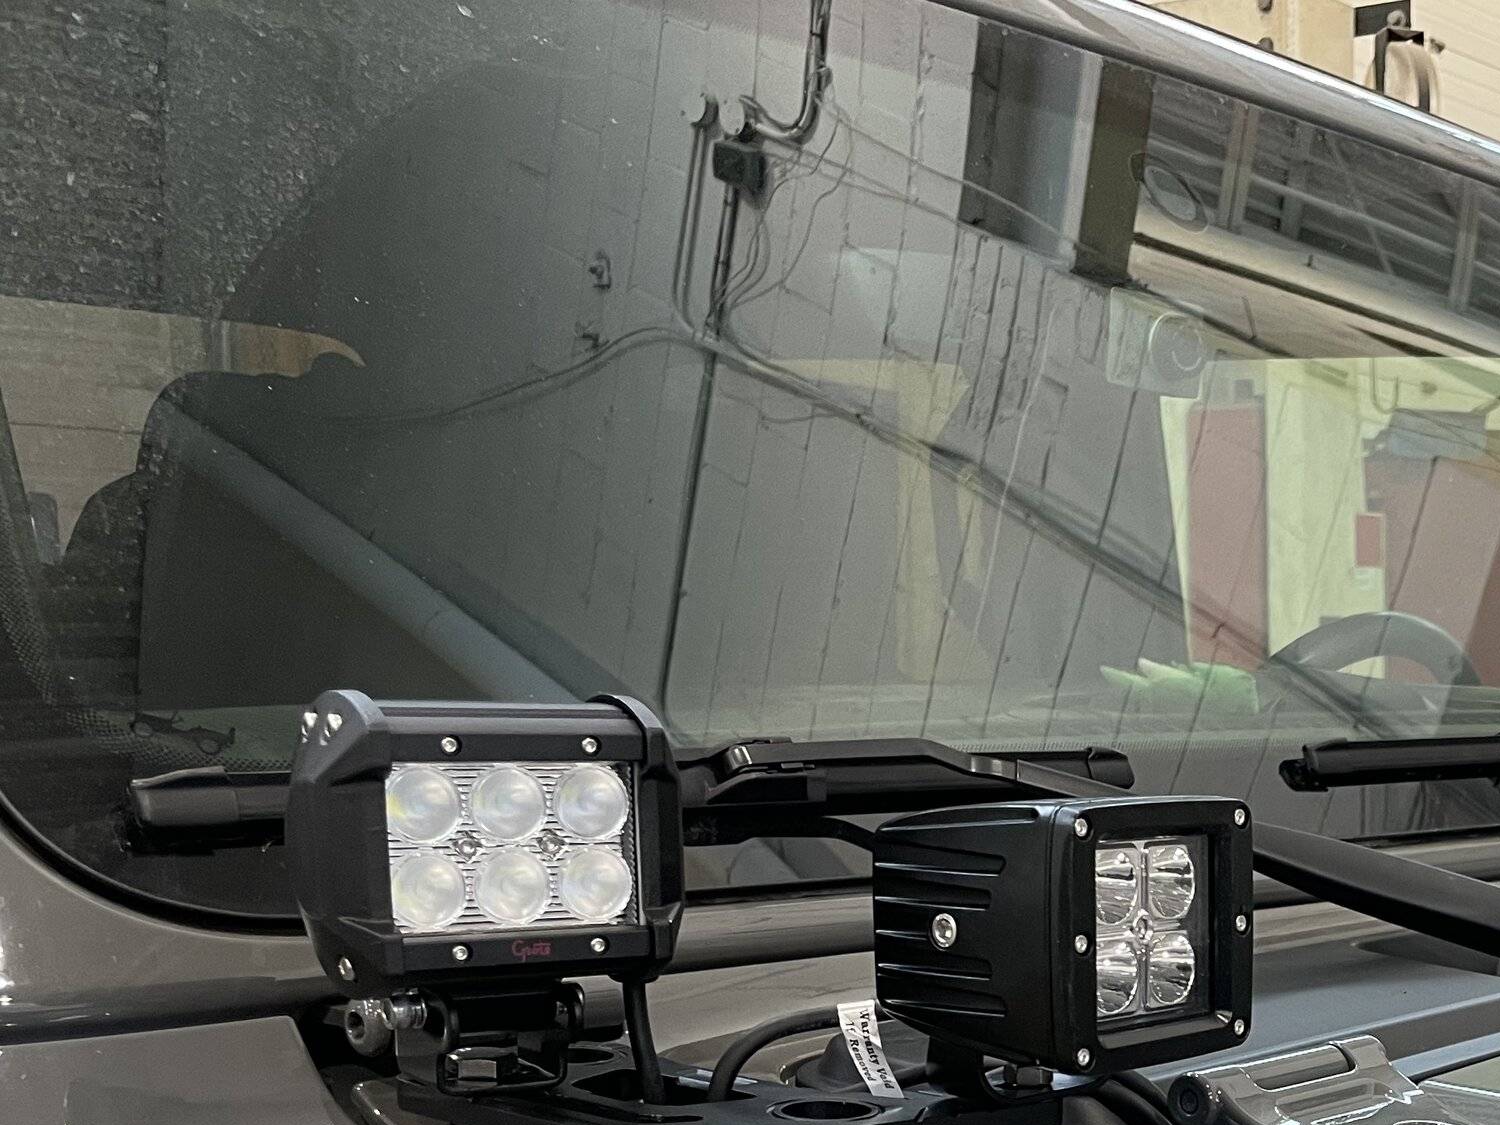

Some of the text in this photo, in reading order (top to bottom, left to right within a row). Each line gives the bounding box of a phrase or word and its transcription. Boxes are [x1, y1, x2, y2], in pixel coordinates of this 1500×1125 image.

[849, 1039, 877, 1082] Removed
[859, 1009, 895, 1089] Warranty Void
